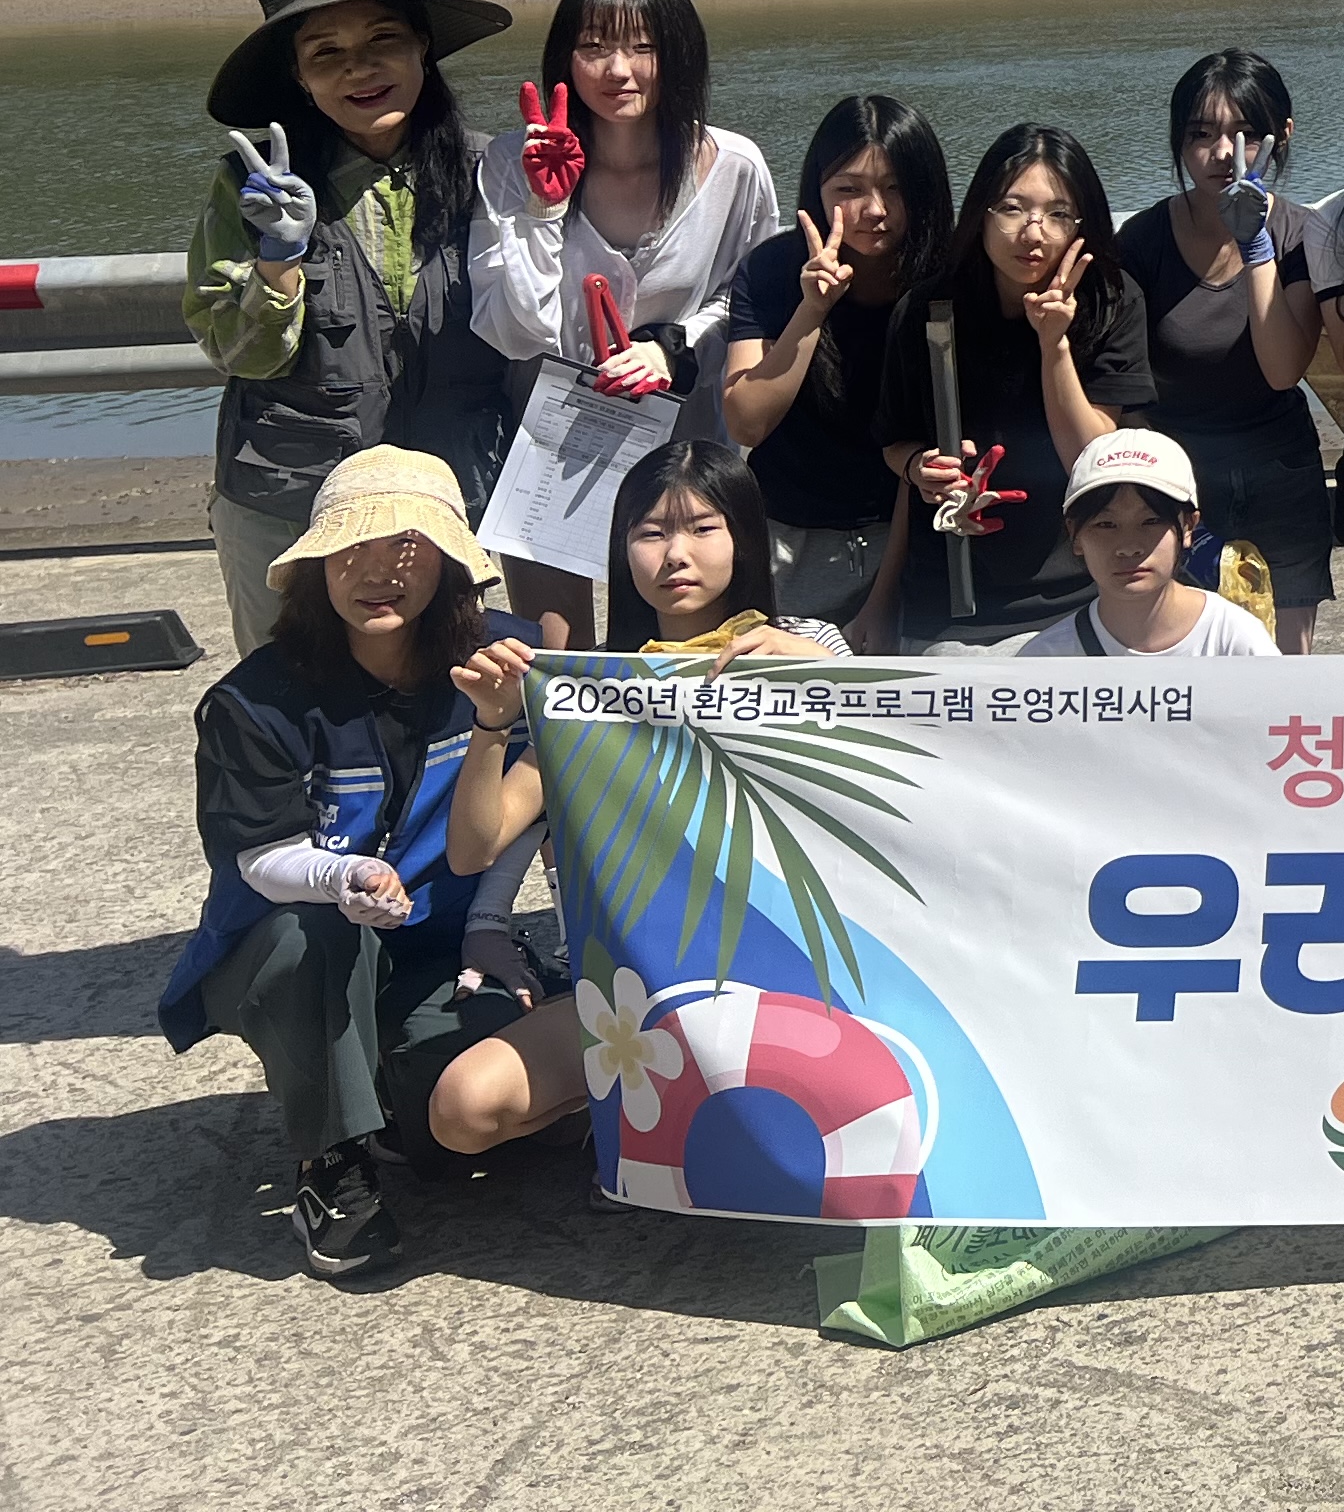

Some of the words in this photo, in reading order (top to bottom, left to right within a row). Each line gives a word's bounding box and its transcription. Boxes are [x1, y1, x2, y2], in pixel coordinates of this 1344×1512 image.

[1096, 450, 1159, 467] CATCHER
[551, 682, 678, 719] 2026년
[691, 683, 974, 724] 환경교육프로그램
[985, 685, 1194, 723] 운영지원사업
